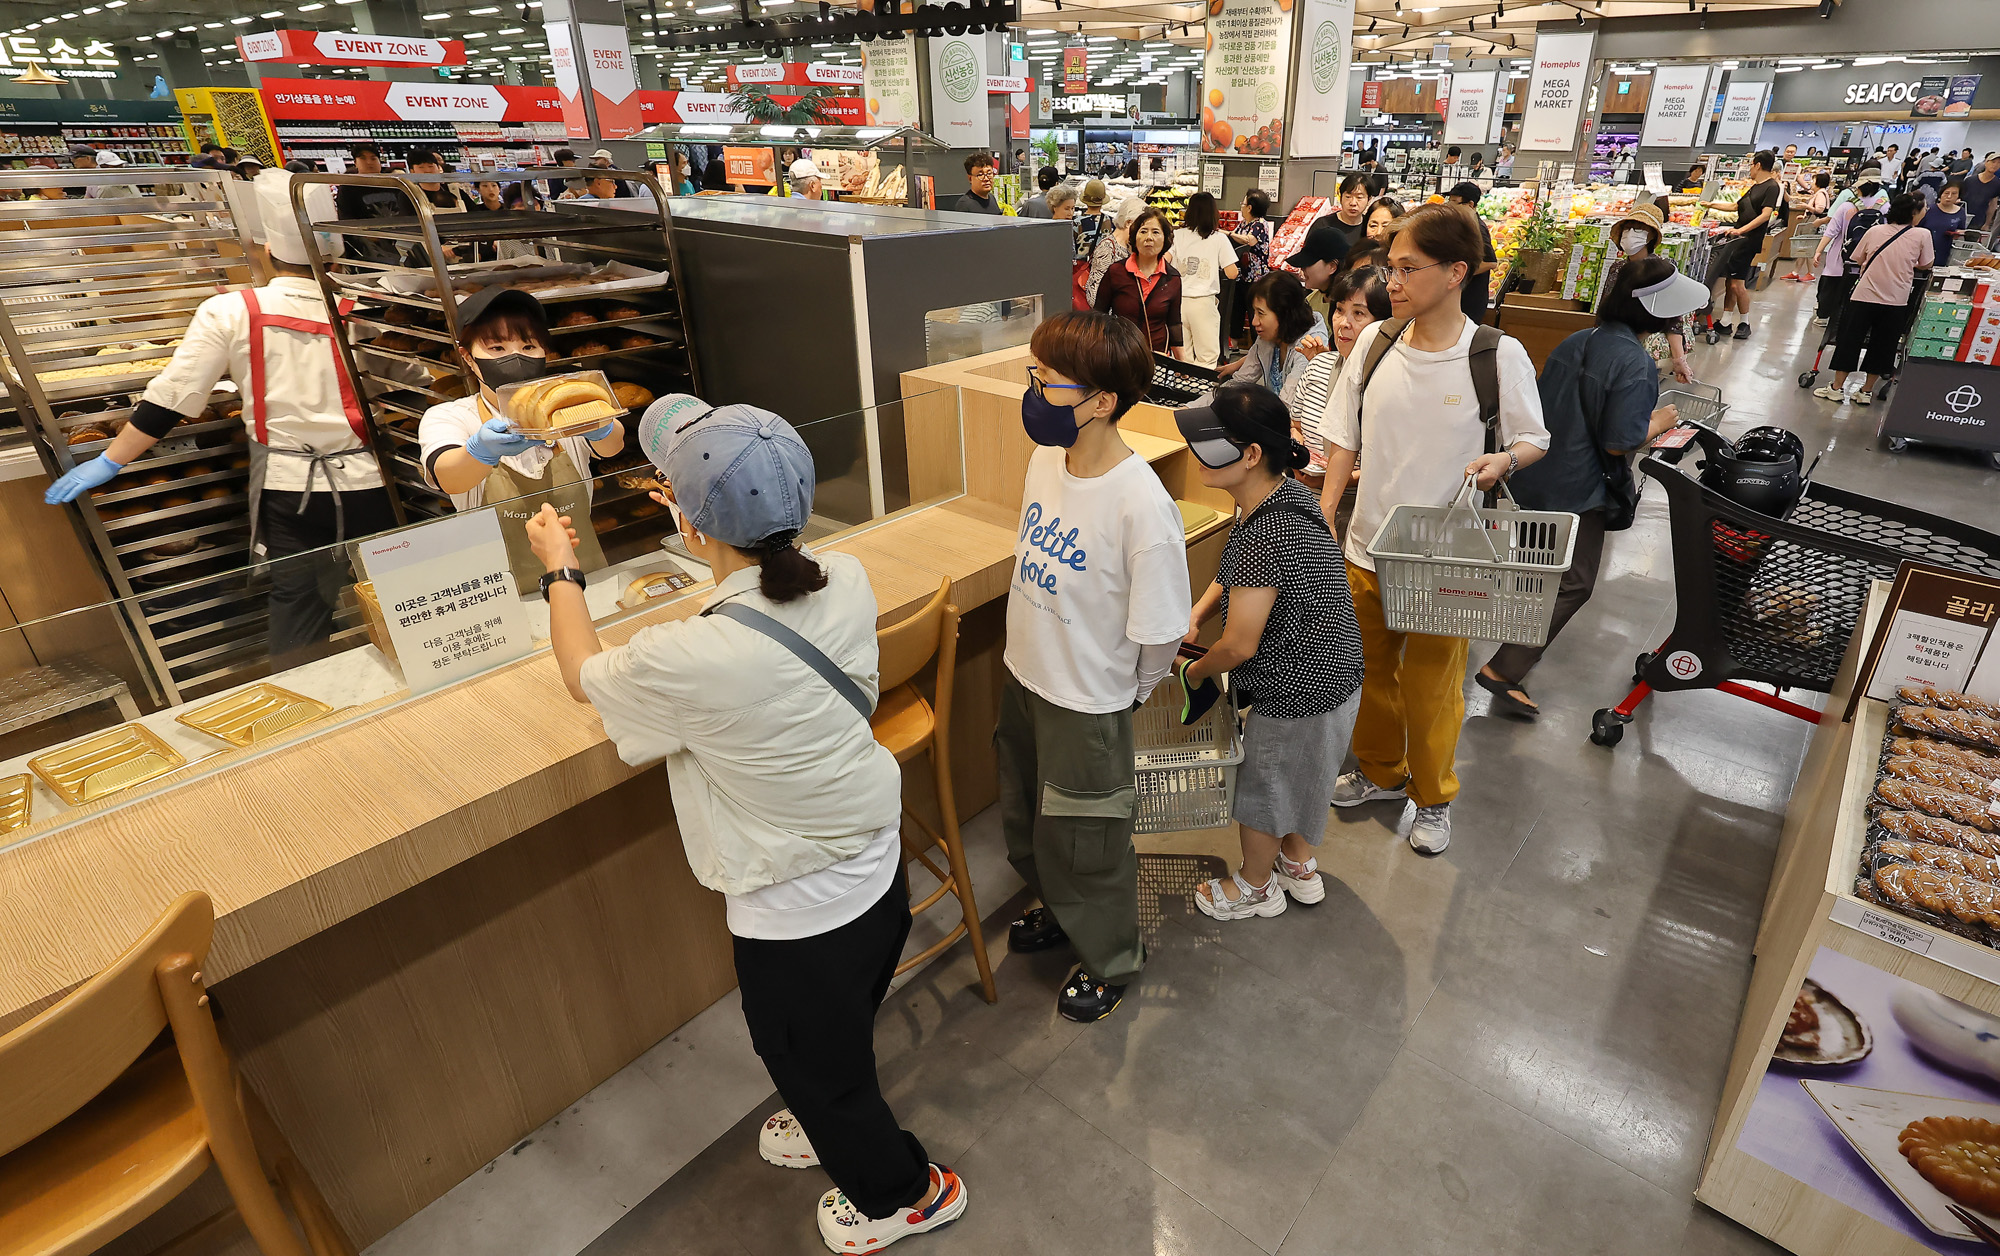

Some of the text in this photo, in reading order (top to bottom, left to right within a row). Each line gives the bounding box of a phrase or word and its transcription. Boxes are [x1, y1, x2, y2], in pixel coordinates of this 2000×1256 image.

[335, 39, 428, 56] EVENT ZONE
[554, 48, 569, 56] EVENT
[593, 50, 622, 59] EVENT
[1314, 46, 1338, 70] 신선농장
[556, 58, 572, 68] ZONE
[596, 60, 625, 70] ZONE
[1540, 60, 1580, 70] Homeplus
[742, 68, 778, 78] EVENT ZONE
[816, 68, 863, 80] EVENT ZONE
[945, 61, 974, 82] 신선농장
[986, 78, 1020, 88] EVENT ZONE
[1543, 80, 1570, 88] MEGA
[1664, 84, 1694, 92] Homeplus
[274, 94, 356, 104] 인기상품을 한 눈에!
[1542, 90, 1569, 98] FOOD
[405, 96, 489, 108] EVENT ZONE
[536, 100, 562, 108] 지금 특
[688, 103, 716, 113] EVENT
[1534, 100, 1573, 108] MARKET
[730, 160, 754, 175] 베이글
[1926, 410, 1986, 428] Homeplus
[504, 510, 527, 519] Mon
[1020, 502, 1086, 572] Petite
[372, 544, 402, 556] Homeplus
[1020, 550, 1058, 595] joie
[394, 572, 504, 613] 이곳은 고객님들을 위한
[1438, 586, 1488, 598] Home plus
[398, 586, 508, 628] 편안한 휴게 공간입니다
[1946, 595, 1996, 622] 골라
[423, 616, 503, 650] 다음 고객님을 위해
[442, 632, 491, 654] 이용 후에는
[432, 636, 507, 670] 정돈 부탁드립니다
[1906, 654, 1950, 671] 해당됩니다
[1880, 930, 1907, 945] 9,900
